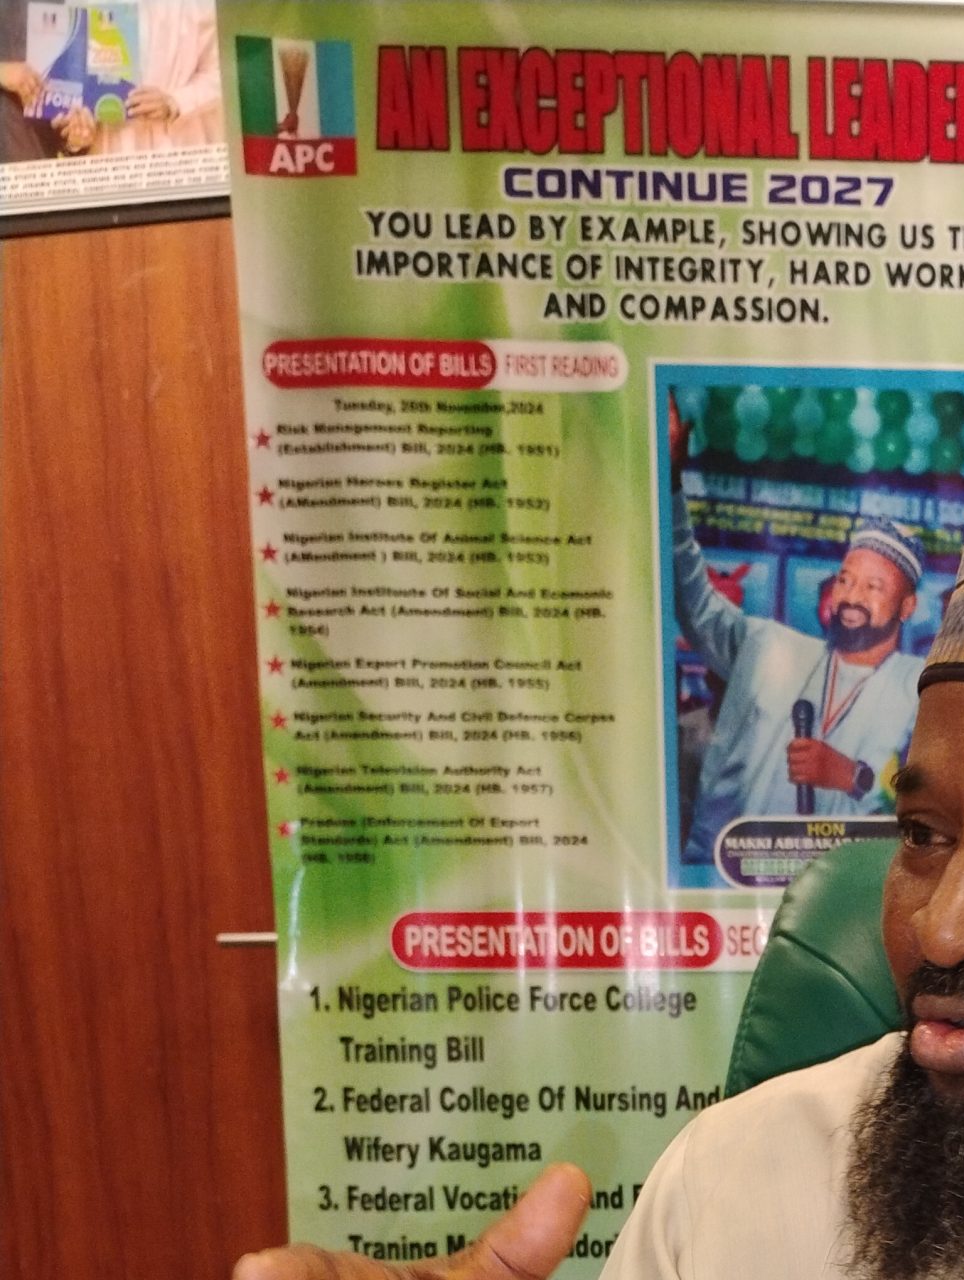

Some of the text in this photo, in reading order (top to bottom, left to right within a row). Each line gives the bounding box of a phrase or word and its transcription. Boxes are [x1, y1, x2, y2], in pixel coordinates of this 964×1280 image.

[376, 45, 449, 152] AN
[461, 46, 799, 159] EXCEPTIONAL
[269, 142, 335, 174] APC
[504, 167, 894, 207] CONTINUE 2027
[367, 211, 433, 239] YOU
[445, 212, 516, 241] LEAD
[529, 215, 568, 243] BY
[580, 216, 727, 249] EXAMPLE,
[741, 220, 887, 250] SHOWING
[899, 223, 936, 250] US
[355, 250, 555, 280] IMPORTANCE
[566, 254, 603, 281] OF
[615, 256, 776, 290] INTEGRITY,
[789, 260, 871, 287] HARD
[542, 291, 830, 324] AND COMPASSION.
[264, 350, 493, 378] PRESENTATION OF BILLS
[505, 353, 619, 378] FIRST READING
[807, 822, 846, 836] HON
[405, 924, 709, 958] PRESENTATION OF BILLS
[726, 925, 767, 956] SEC
[310, 986, 697, 1018] 1. Nigerian Police Force College
[340, 1036, 485, 1068] Training Bill
[313, 1086, 721, 1118] 2. Federal College Of Nursing And
[344, 1136, 541, 1169] Wifery Kaugama
[318, 1185, 339, 1212] 3.
[347, 1185, 435, 1212] Federal
[443, 1185, 518, 1212] Vocati
